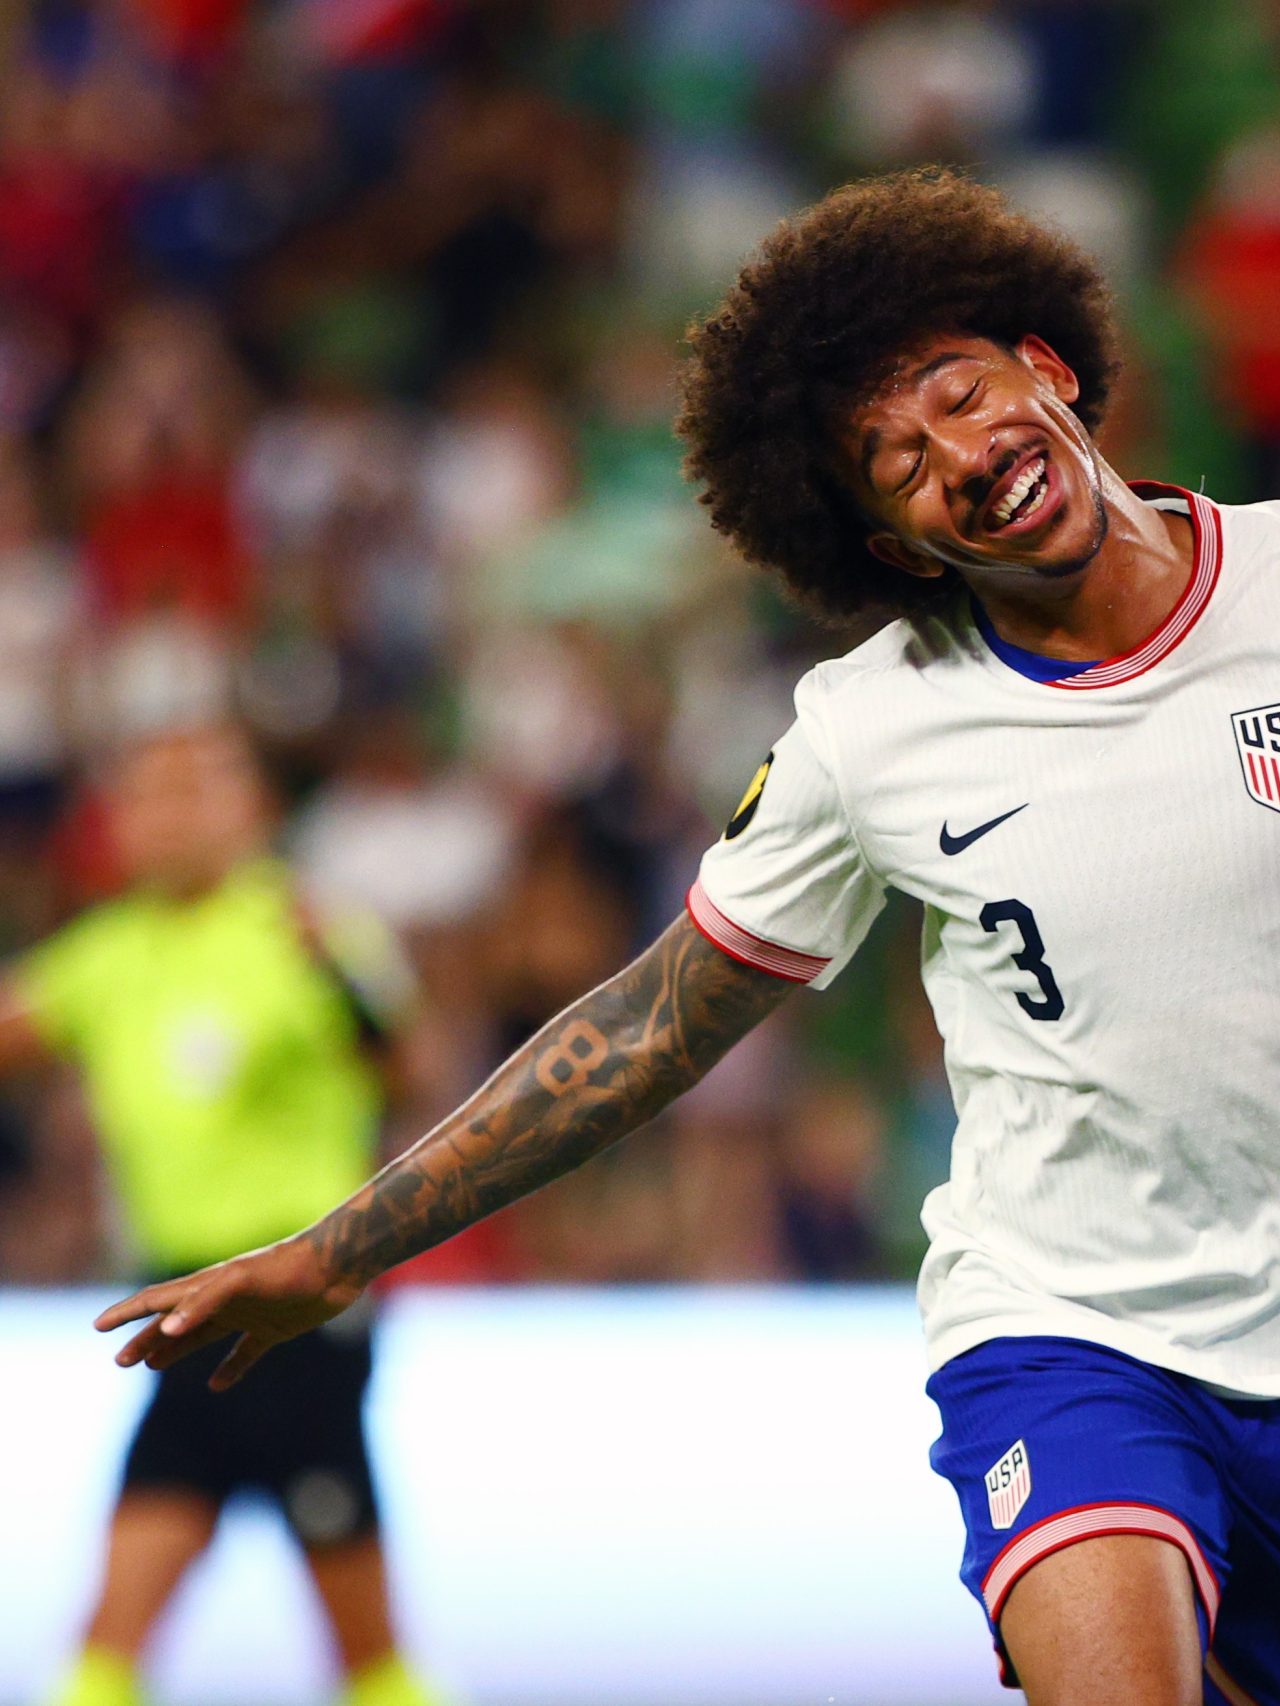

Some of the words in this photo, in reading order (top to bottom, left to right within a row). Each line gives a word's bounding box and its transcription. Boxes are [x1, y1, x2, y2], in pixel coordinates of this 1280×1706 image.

[979, 898, 1066, 1022] 3
[536, 1019, 609, 1098] 8
[988, 1447, 1023, 1493] USA
